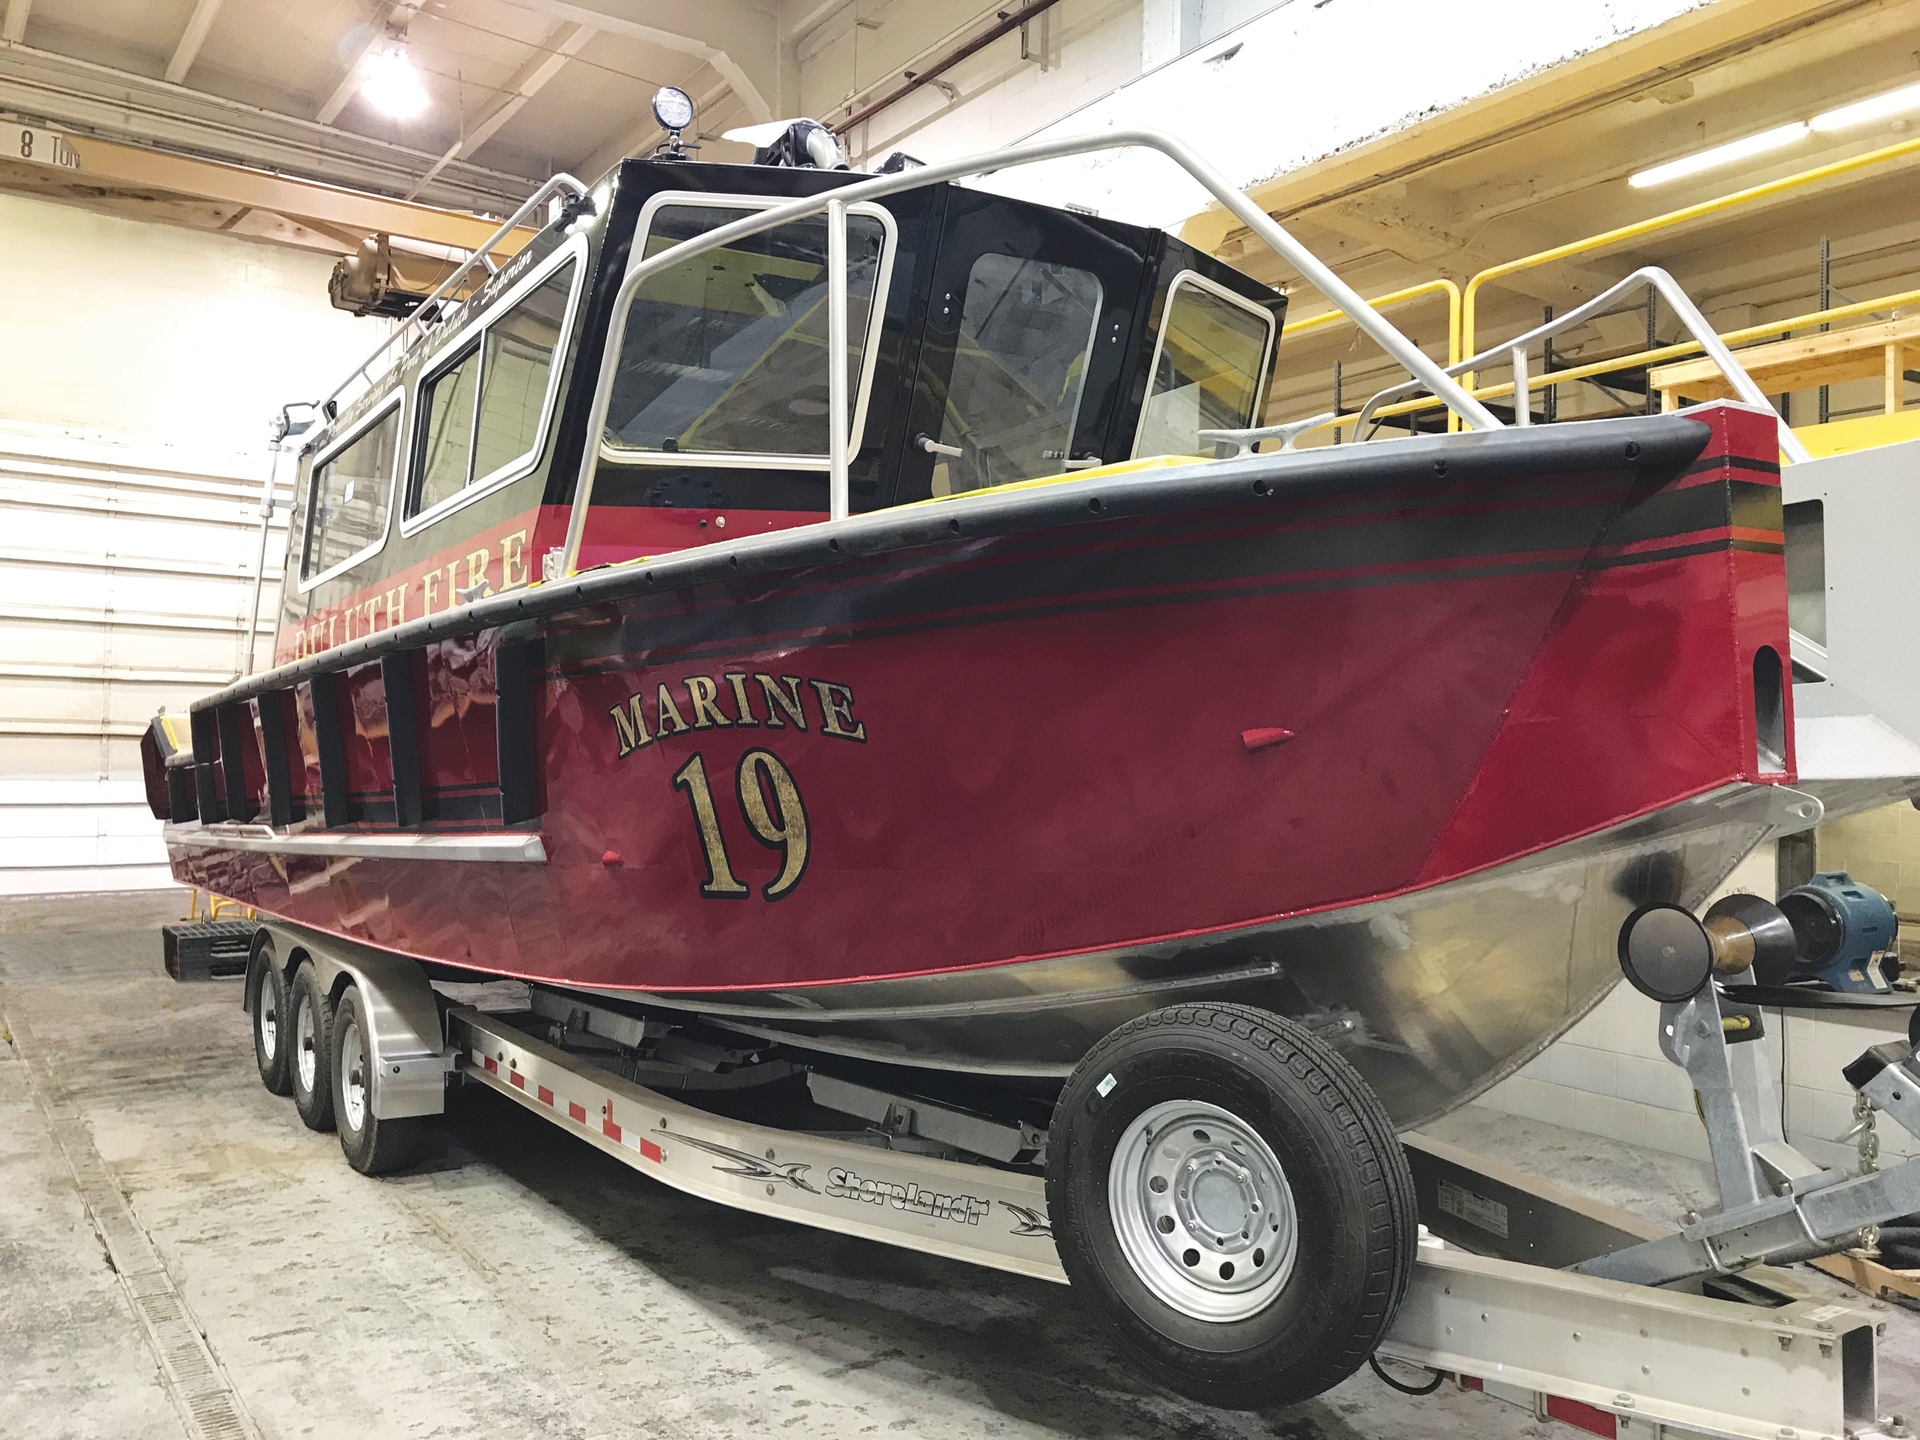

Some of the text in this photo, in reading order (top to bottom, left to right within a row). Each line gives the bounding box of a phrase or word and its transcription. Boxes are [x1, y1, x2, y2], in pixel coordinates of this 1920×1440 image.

[20, 129, 34, 158] 8
[434, 298, 471, 348] Duluth
[481, 249, 533, 306] Superior
[294, 528, 529, 661] DULUTH FIRE
[609, 672, 867, 759] MARINE
[672, 747, 811, 902] 19
